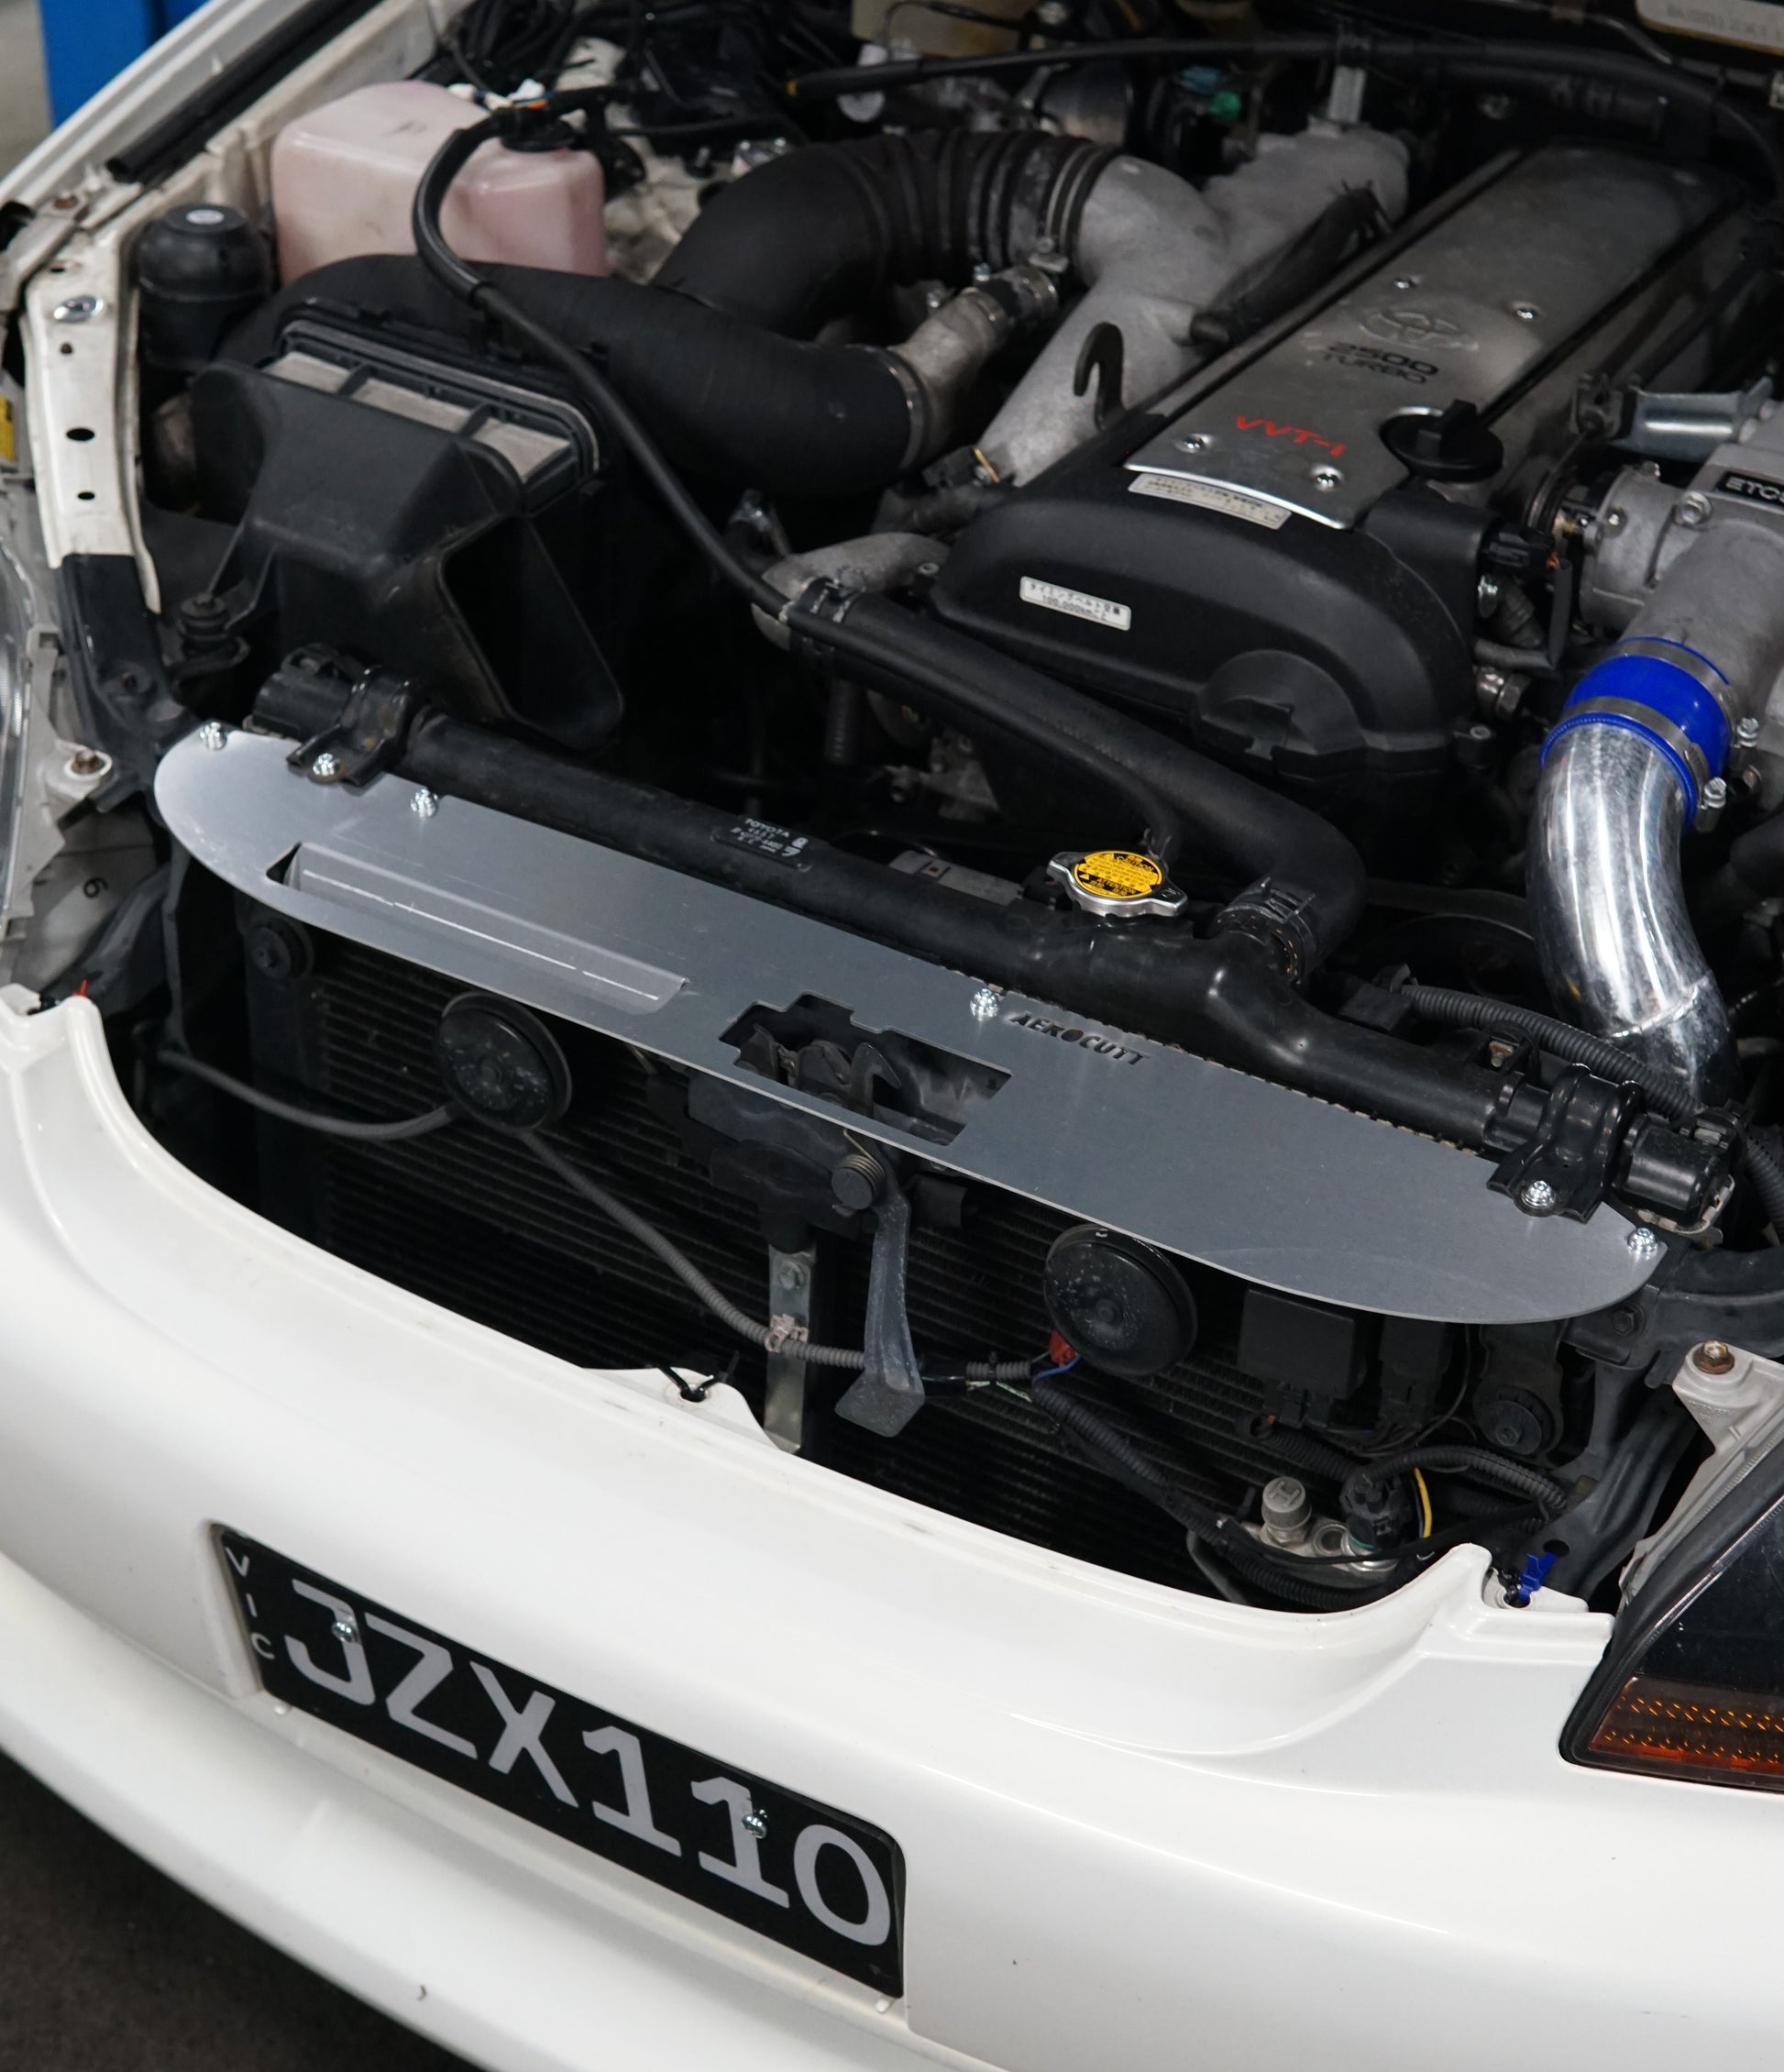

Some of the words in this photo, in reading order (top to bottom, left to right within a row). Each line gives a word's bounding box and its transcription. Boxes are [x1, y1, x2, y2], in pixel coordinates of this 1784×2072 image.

[1324, 353, 1427, 384] TURBO
[1329, 343, 1439, 376] 2500
[744, 818, 790, 839] TOYOTA
[1008, 1011, 1149, 1065] AEROCUTT
[283, 1578, 891, 1946] JZX110
